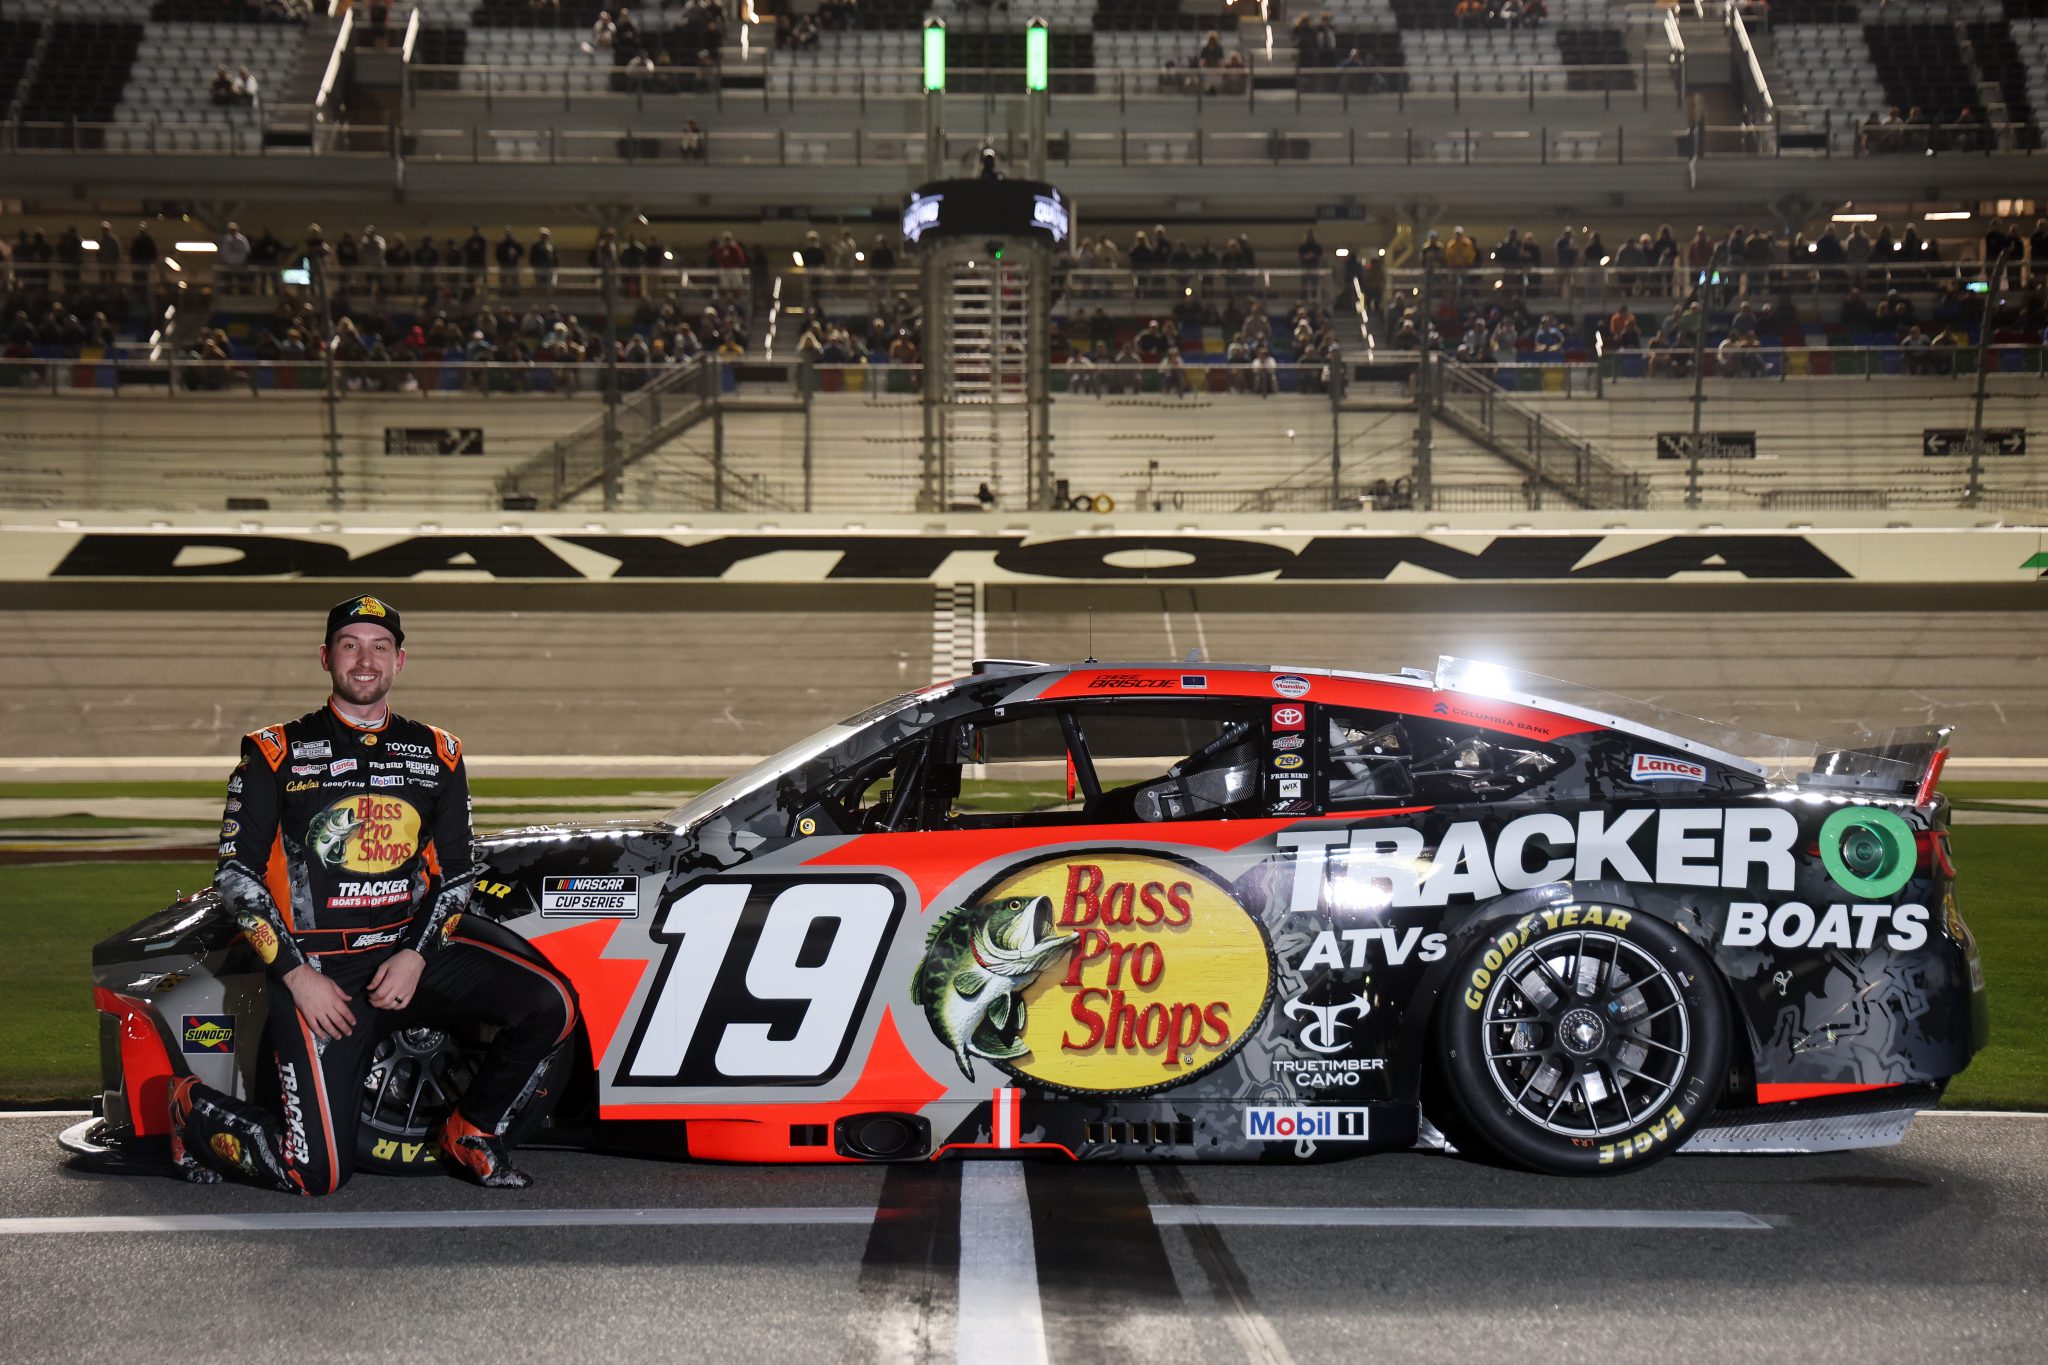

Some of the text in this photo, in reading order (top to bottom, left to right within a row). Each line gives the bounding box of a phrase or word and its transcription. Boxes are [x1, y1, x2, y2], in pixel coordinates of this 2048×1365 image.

[49, 534, 1856, 580] DAYTONA
[1087, 679, 1179, 688] BRISCOE
[1452, 707, 1514, 727] COLUMBIA
[1517, 722, 1550, 736] BANK
[385, 742, 432, 755] TOYOTA
[332, 760, 355, 772] Lance
[405, 760, 439, 774] REDHEAD
[1278, 756, 1300, 767] zep
[1637, 755, 1703, 776] Lance
[285, 778, 320, 792] Cabela's
[371, 776, 394, 786] Mobil
[1270, 772, 1290, 780] FREE
[1282, 782, 1298, 791] WIX
[356, 797, 403, 819] Bass
[357, 819, 393, 840] Pro
[357, 839, 412, 865] Shops
[1276, 806, 1799, 912] TRACKER
[338, 879, 409, 897] TRACKER
[573, 879, 625, 890] NASCAR
[331, 898, 361, 906] BOATS
[555, 896, 625, 908] CUP SERIES
[1056, 864, 1194, 927] Bass
[1721, 902, 1930, 951] BOATS
[1059, 927, 1165, 987] Pro
[1298, 926, 1448, 971] ATVs
[628, 883, 896, 1077] 19
[187, 1029, 232, 1040] SUNOCO
[1060, 986, 1230, 1066] Shops
[1272, 1058, 1384, 1072] TRUETIMBER
[1295, 1072, 1360, 1087] CAMO
[281, 1062, 310, 1165] TRACKER
[1250, 1111, 1331, 1136] Mobil
[1598, 1104, 1686, 1164] EAGLE
